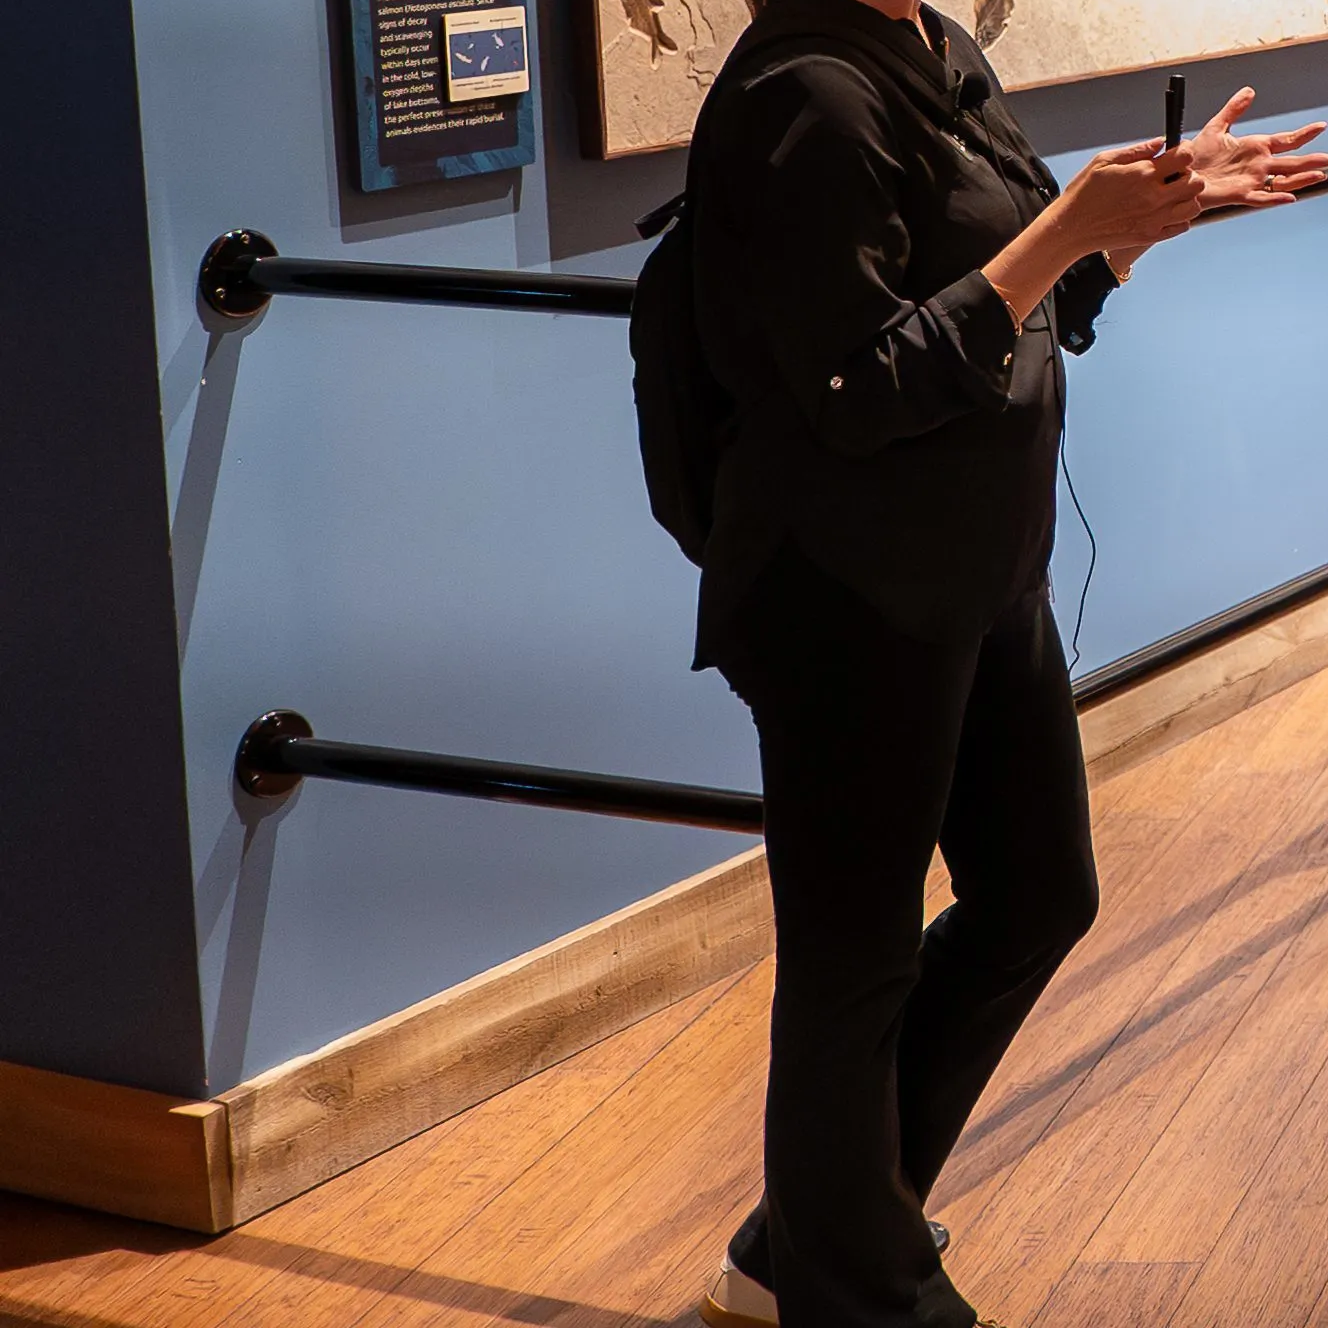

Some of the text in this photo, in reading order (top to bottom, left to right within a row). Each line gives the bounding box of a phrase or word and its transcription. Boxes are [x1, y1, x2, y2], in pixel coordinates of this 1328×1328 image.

[378, 6, 404, 16] salmon
[378, 16, 428, 30] signs of decay
[380, 30, 433, 43] and scavenging
[380, 43, 430, 56] typically occur
[381, 56, 439, 70] within days even
[382, 70, 437, 84] in the cold, low-
[382, 83, 434, 98] oxygen depths
[384, 95, 440, 110] of lake bottoms,
[384, 116, 396, 124] the
[397, 111, 424, 123] perfect
[385, 110, 505, 138] animals evidences their rapid burial.
